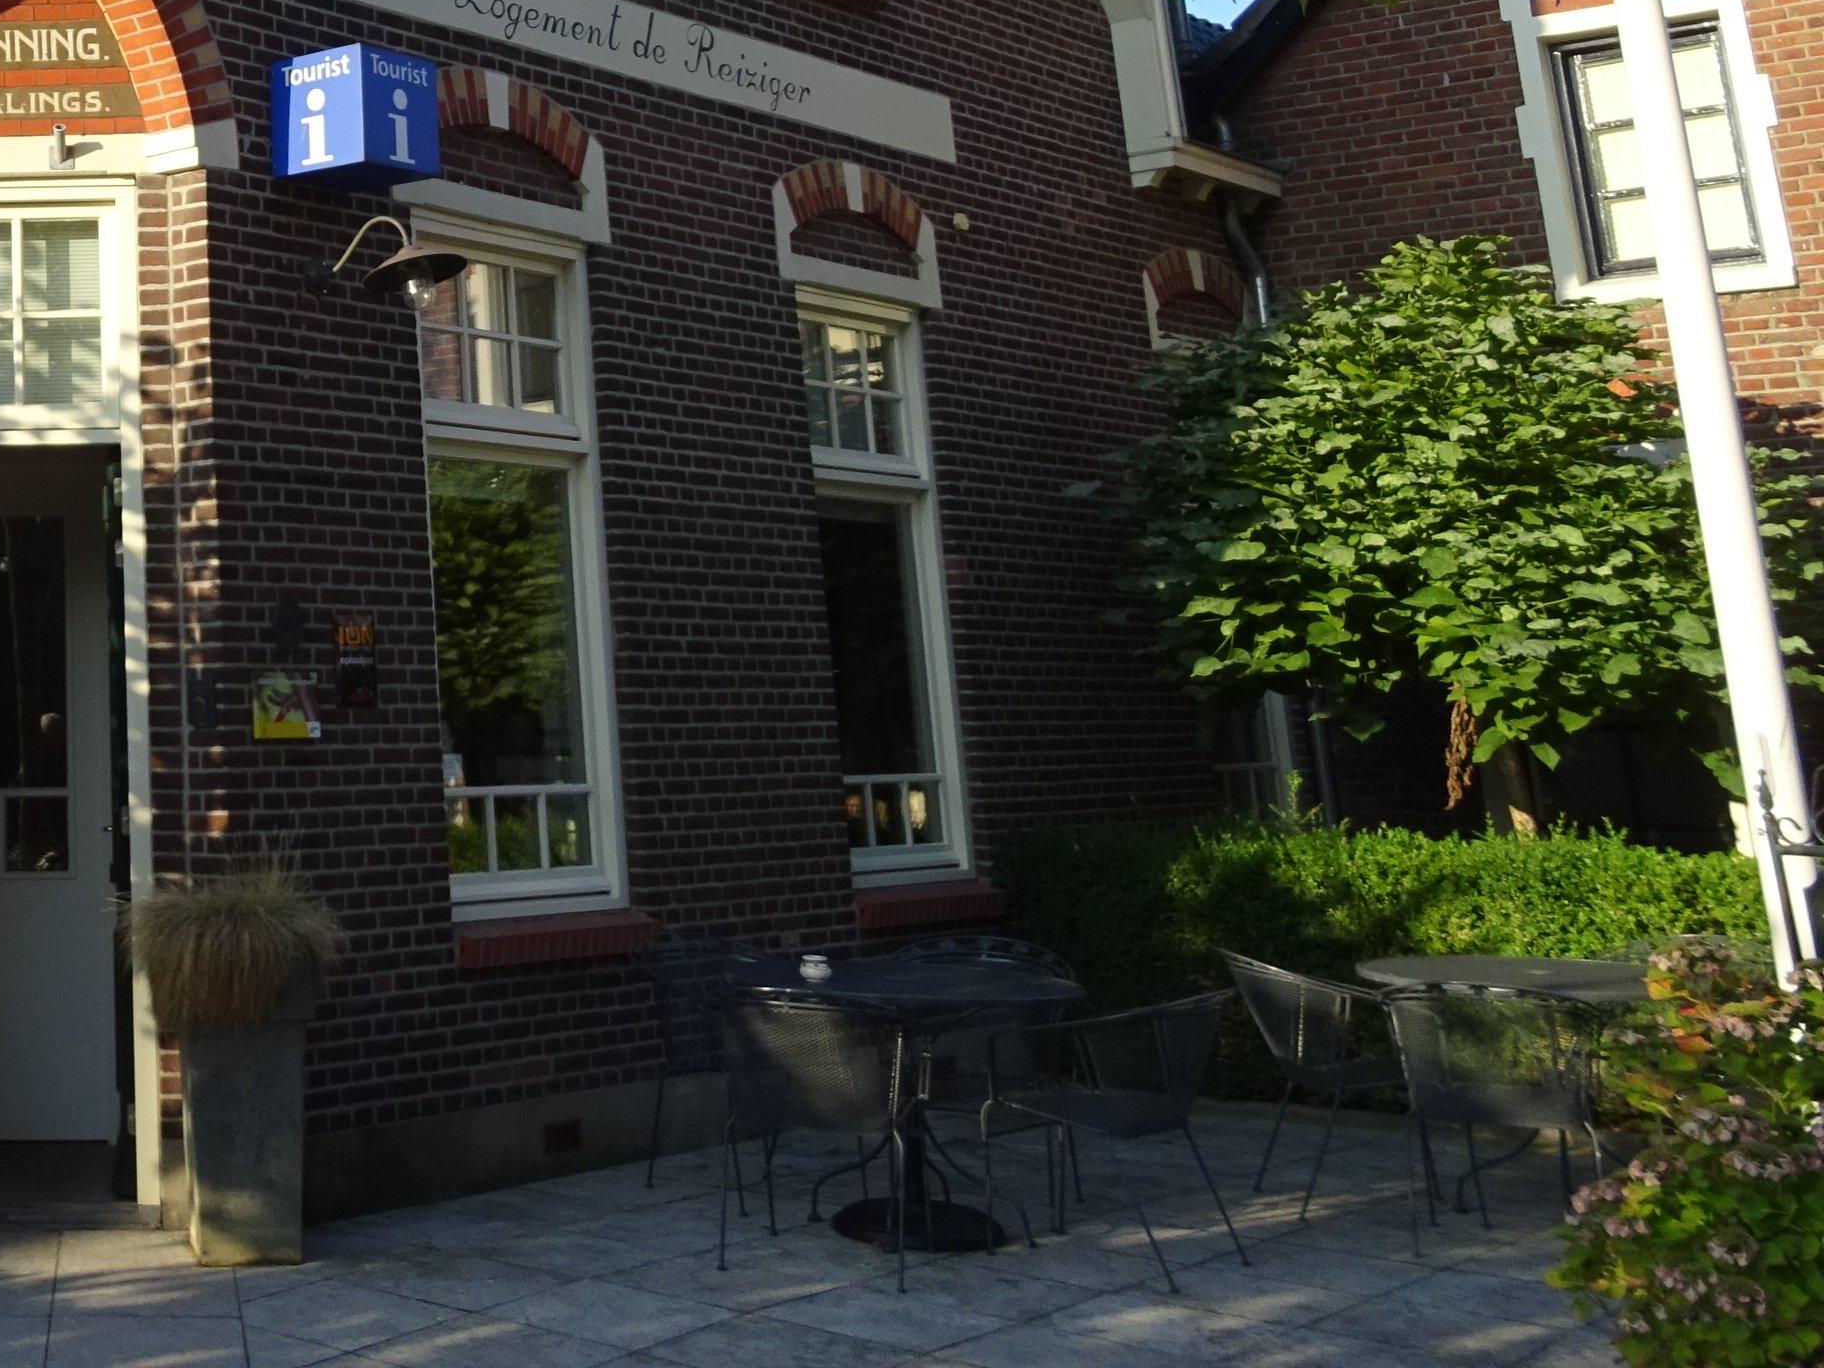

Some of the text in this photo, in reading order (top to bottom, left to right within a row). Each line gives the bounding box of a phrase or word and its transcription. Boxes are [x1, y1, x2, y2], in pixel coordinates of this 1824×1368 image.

[281, 53, 351, 87] Tourist
[369, 53, 429, 87] Tourist
[633, 12, 666, 64] de
[684, 23, 811, 111] Reiziger
